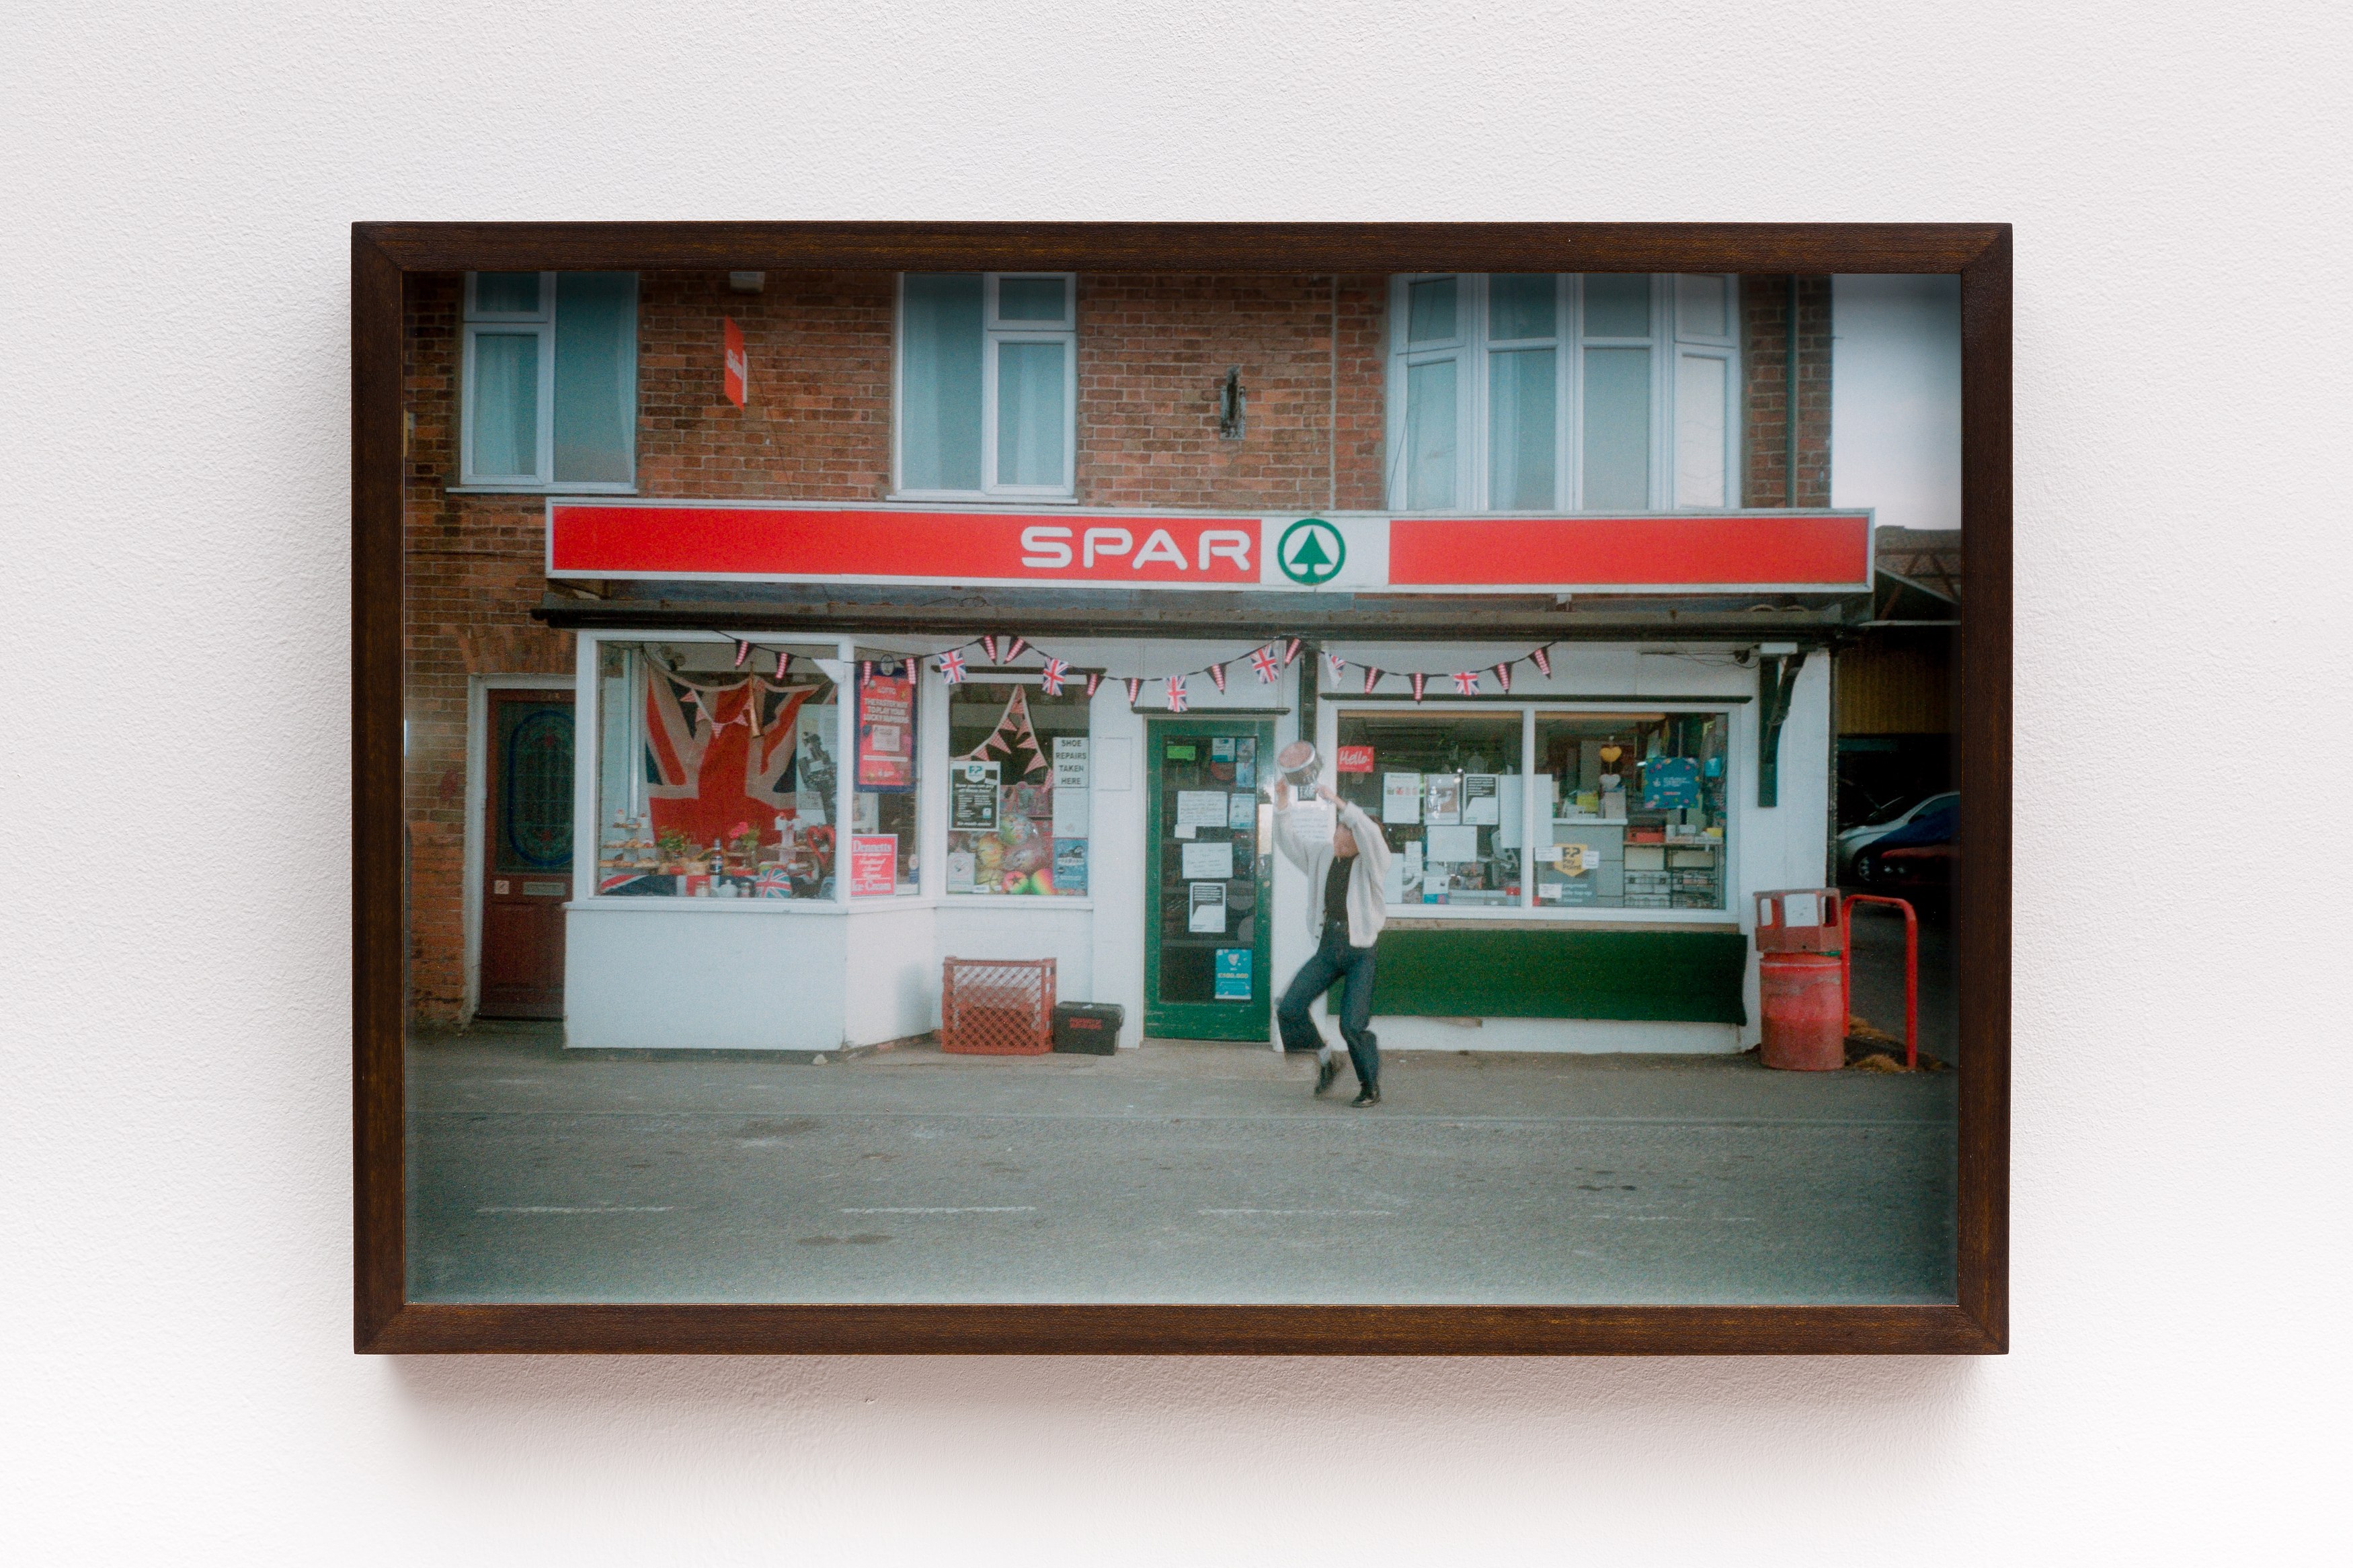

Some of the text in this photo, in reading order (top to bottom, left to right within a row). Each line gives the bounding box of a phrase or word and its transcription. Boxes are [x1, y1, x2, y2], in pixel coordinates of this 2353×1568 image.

[1021, 526, 1250, 571] SPAR
[1062, 739, 1082, 747] SHOE
[853, 840, 891, 853] Dennetts
[852, 880, 863, 891] Ice
